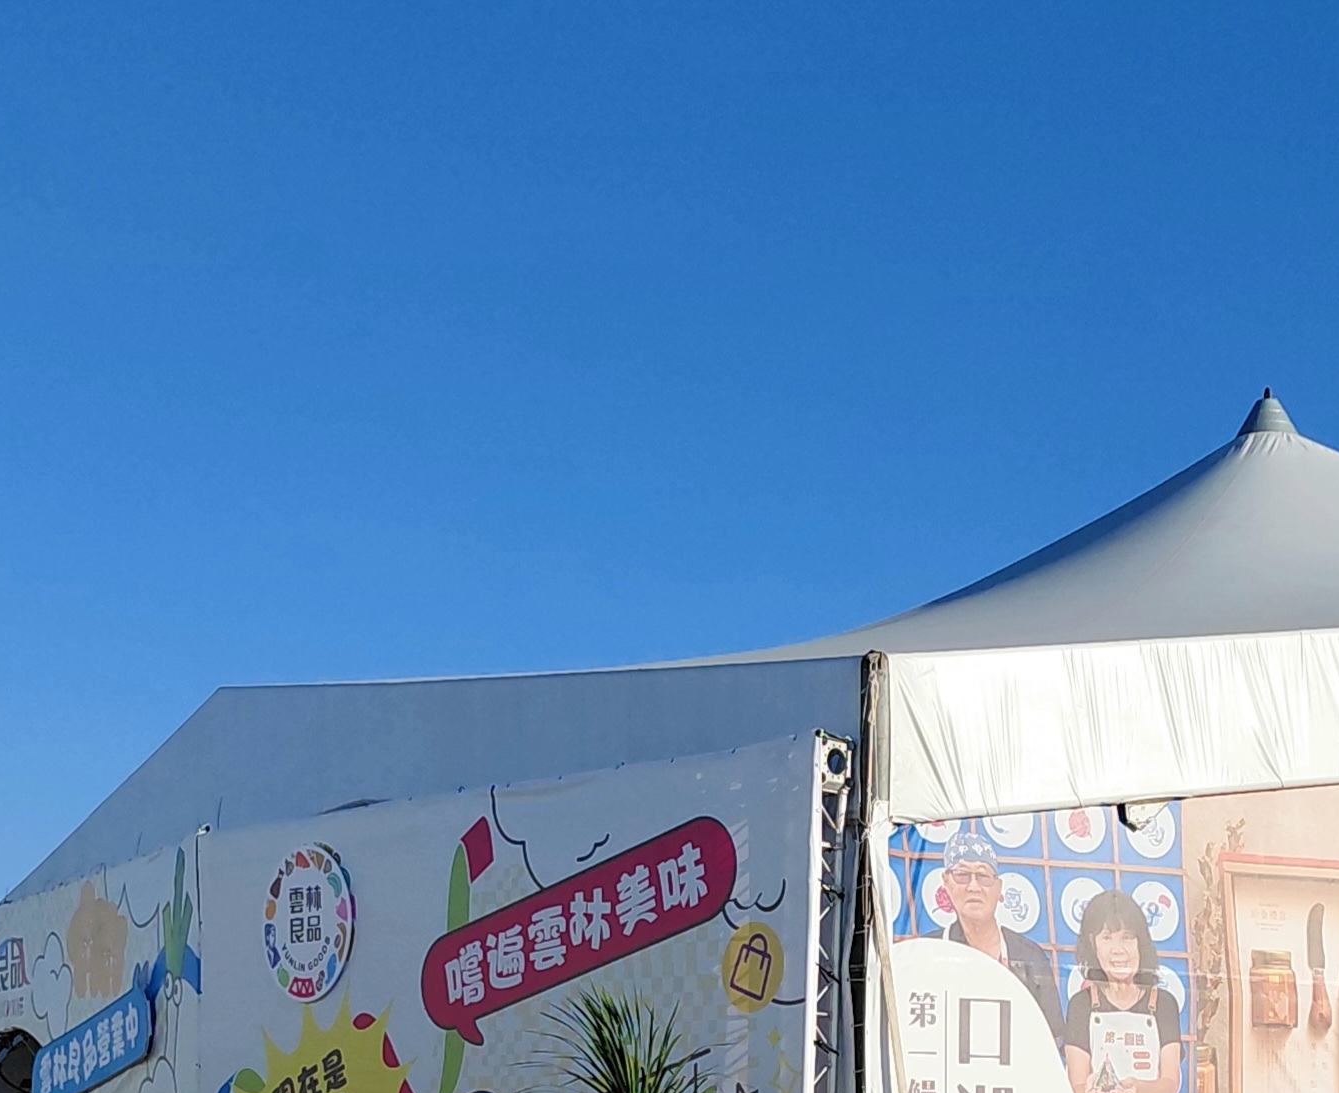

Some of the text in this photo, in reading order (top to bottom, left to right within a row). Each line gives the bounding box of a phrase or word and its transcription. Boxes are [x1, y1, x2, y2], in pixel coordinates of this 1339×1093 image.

[289, 885, 322, 914] 雲林
[290, 915, 322, 944] 良品
[444, 842, 708, 1006] 嚐遍雲林美味
[281, 936, 331, 972] YUNLIN GOODS
